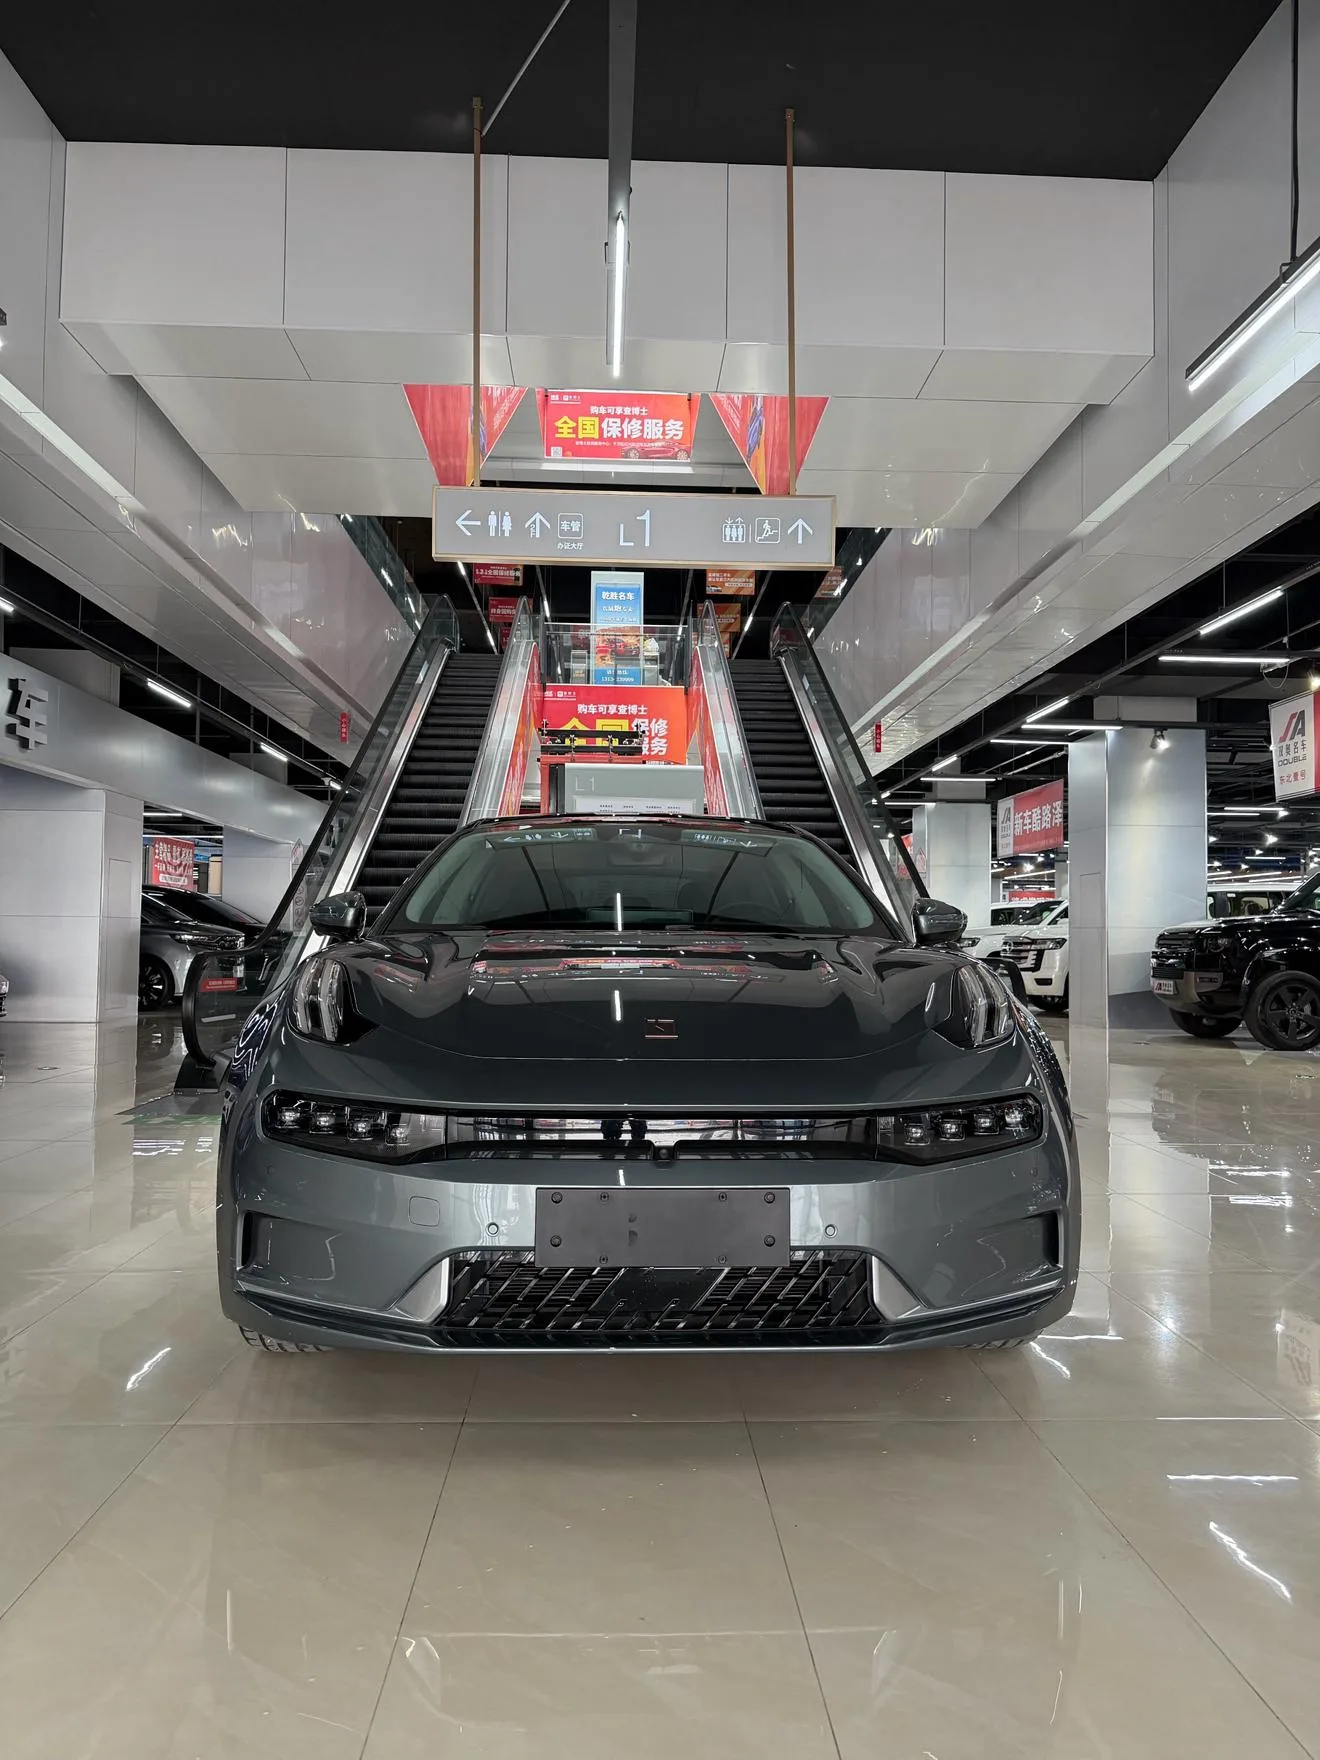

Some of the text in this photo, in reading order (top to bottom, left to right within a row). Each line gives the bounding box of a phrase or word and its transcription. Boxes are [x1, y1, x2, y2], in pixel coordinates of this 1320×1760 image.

[555, 415, 684, 441] 全国保修服务
[560, 520, 581, 532] 车管
[620, 509, 650, 547] L1
[557, 542, 584, 550] 办证大厅
[577, 703, 648, 715] 购车可享查博士
[575, 776, 596, 791] L1
[1014, 800, 1064, 836] 新车酷路泽
